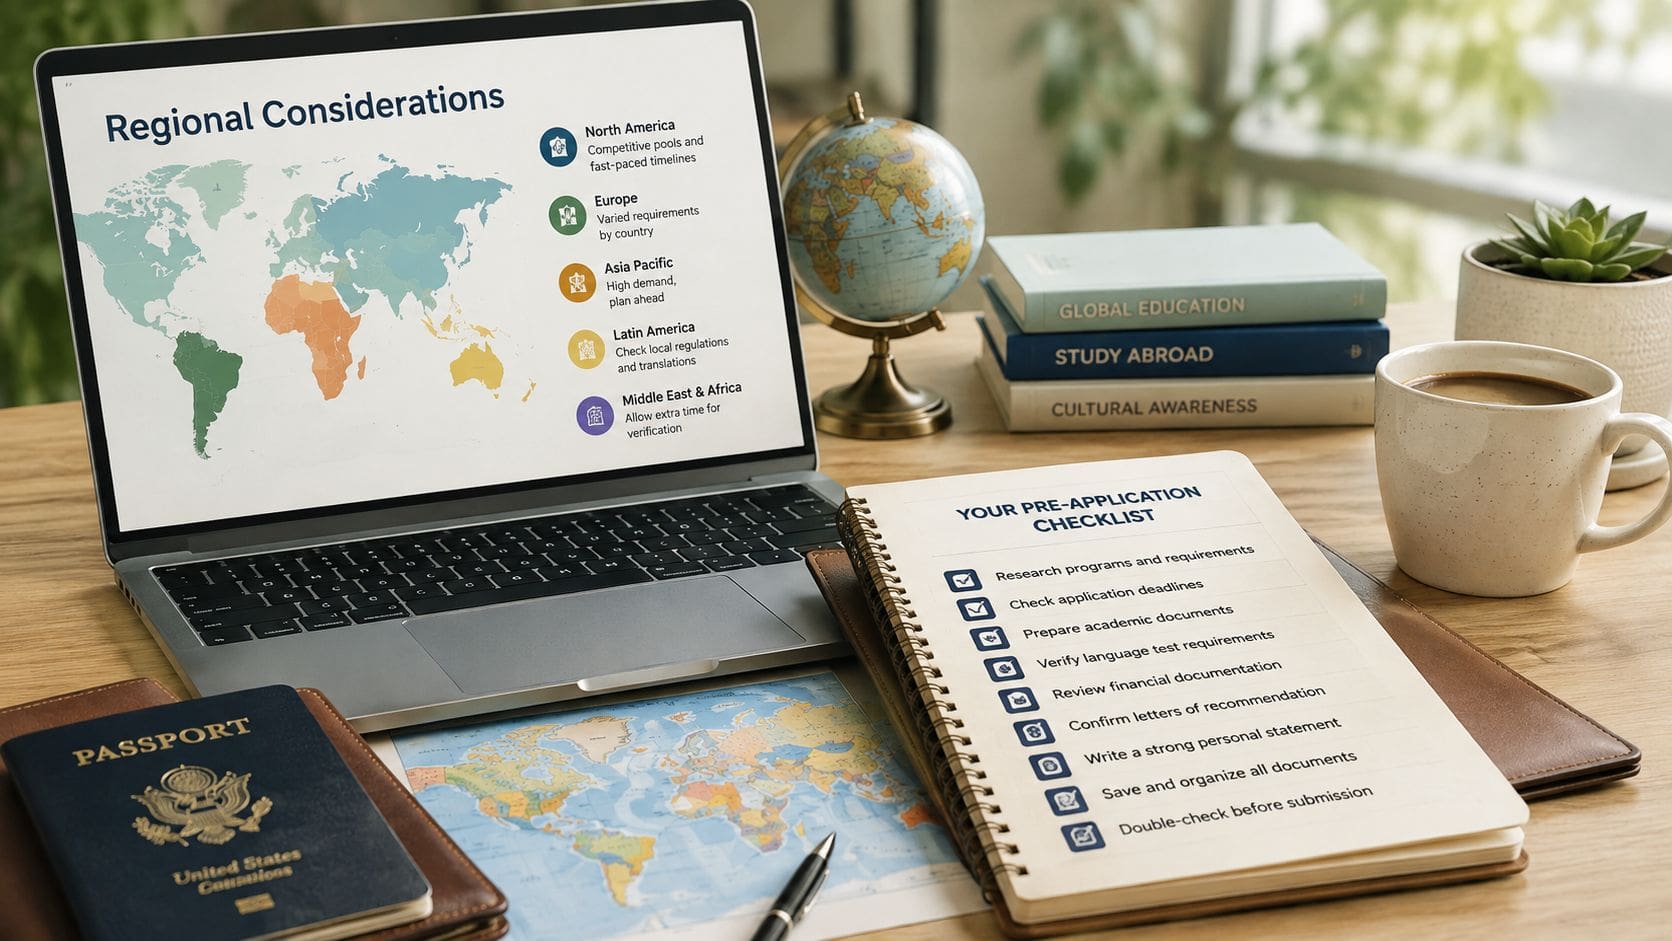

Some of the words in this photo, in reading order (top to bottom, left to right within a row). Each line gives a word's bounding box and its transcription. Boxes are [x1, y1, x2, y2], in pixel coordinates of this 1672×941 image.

[105, 101, 254, 145] Regional
[262, 85, 504, 128] Considerations
[585, 123, 621, 137] North
[624, 121, 675, 134] America
[587, 140, 650, 155] Competitive
[653, 137, 682, 151] pools
[684, 134, 704, 146] and
[589, 156, 647, 172] fast-paced
[649, 154, 696, 166] timelines
[594, 194, 637, 207] Europe
[596, 211, 630, 224] Varied
[632, 206, 699, 222] requirements
[599, 229, 612, 241] by
[614, 227, 653, 238] country
[604, 261, 630, 274] Asia
[633, 257, 673, 271] Pacific
[606, 279, 630, 292] High
[632, 274, 676, 288] demand,
[609, 296, 631, 309] plan
[633, 291, 664, 304] ahead
[1059, 301, 1132, 319] GLOBAL
[1138, 297, 1246, 316] EDUCATION
[613, 327, 643, 340] Latin
[646, 323, 695, 337] America
[615, 345, 647, 357] Check
[648, 341, 672, 353] local
[674, 337, 729, 352] regulations
[1055, 348, 1121, 365] STUDY
[1127, 346, 1213, 363] ABROAD
[617, 361, 636, 373] and
[638, 356, 696, 370] translations
[622, 391, 663, 406] Middle
[666, 387, 692, 401] East
[695, 386, 704, 397] &
[707, 383, 742, 396] Africa
[625, 411, 652, 423] Allow
[655, 409, 680, 419] extra
[682, 406, 704, 416] time
[706, 402, 720, 413] for
[1052, 401, 1142, 417] CULTURAL
[1148, 398, 1257, 415] AWARENESS
[626, 423, 682, 438] verification
[955, 503, 1018, 520] YOUR
[1020, 486, 1201, 514] PRE-APPLICATION
[1033, 508, 1154, 532] CHECKLIST
[995, 566, 1062, 581] Research
[1064, 560, 1132, 575] programs
[1135, 554, 1162, 566] and
[1164, 545, 1254, 562] requirements
[1009, 596, 1055, 609] Check
[1058, 588, 1135, 605] application
[1138, 581, 1204, 594] deadlines
[1022, 625, 1080, 639] Prepare
[1084, 615, 1153, 631] academic
[1155, 606, 1233, 622] documents
[1036, 654, 1079, 668] Verify
[1082, 648, 1149, 662] language
[1152, 642, 1180, 653] test
[1182, 631, 1274, 649] requirements
[1052, 685, 1105, 699] Review
[1109, 673, 1171, 691] financial
[1174, 661, 1282, 682] documentation
[1068, 715, 1131, 731] Confirm
[1132, 708, 1182, 721] letters
[1185, 702, 1199, 714] of
[1203, 687, 1326, 711] recommendation
[72, 717, 250, 766] PASSPORT
[1083, 750, 1127, 764] Write
[1131, 749, 1141, 757] a
[1144, 741, 1195, 755] strong
[1197, 728, 1262, 750] personal
[1265, 718, 1342, 737] statement
[1101, 786, 1141, 799] Save
[1145, 778, 1176, 793] and
[1179, 769, 1246, 787] organize
[1249, 763, 1268, 776] all
[1271, 752, 1357, 772] documents
[1118, 808, 1229, 835] Double-check
[1230, 801, 1283, 816] before
[1286, 787, 1373, 808] submission
[173, 859, 239, 884] United
[243, 849, 301, 870] States
